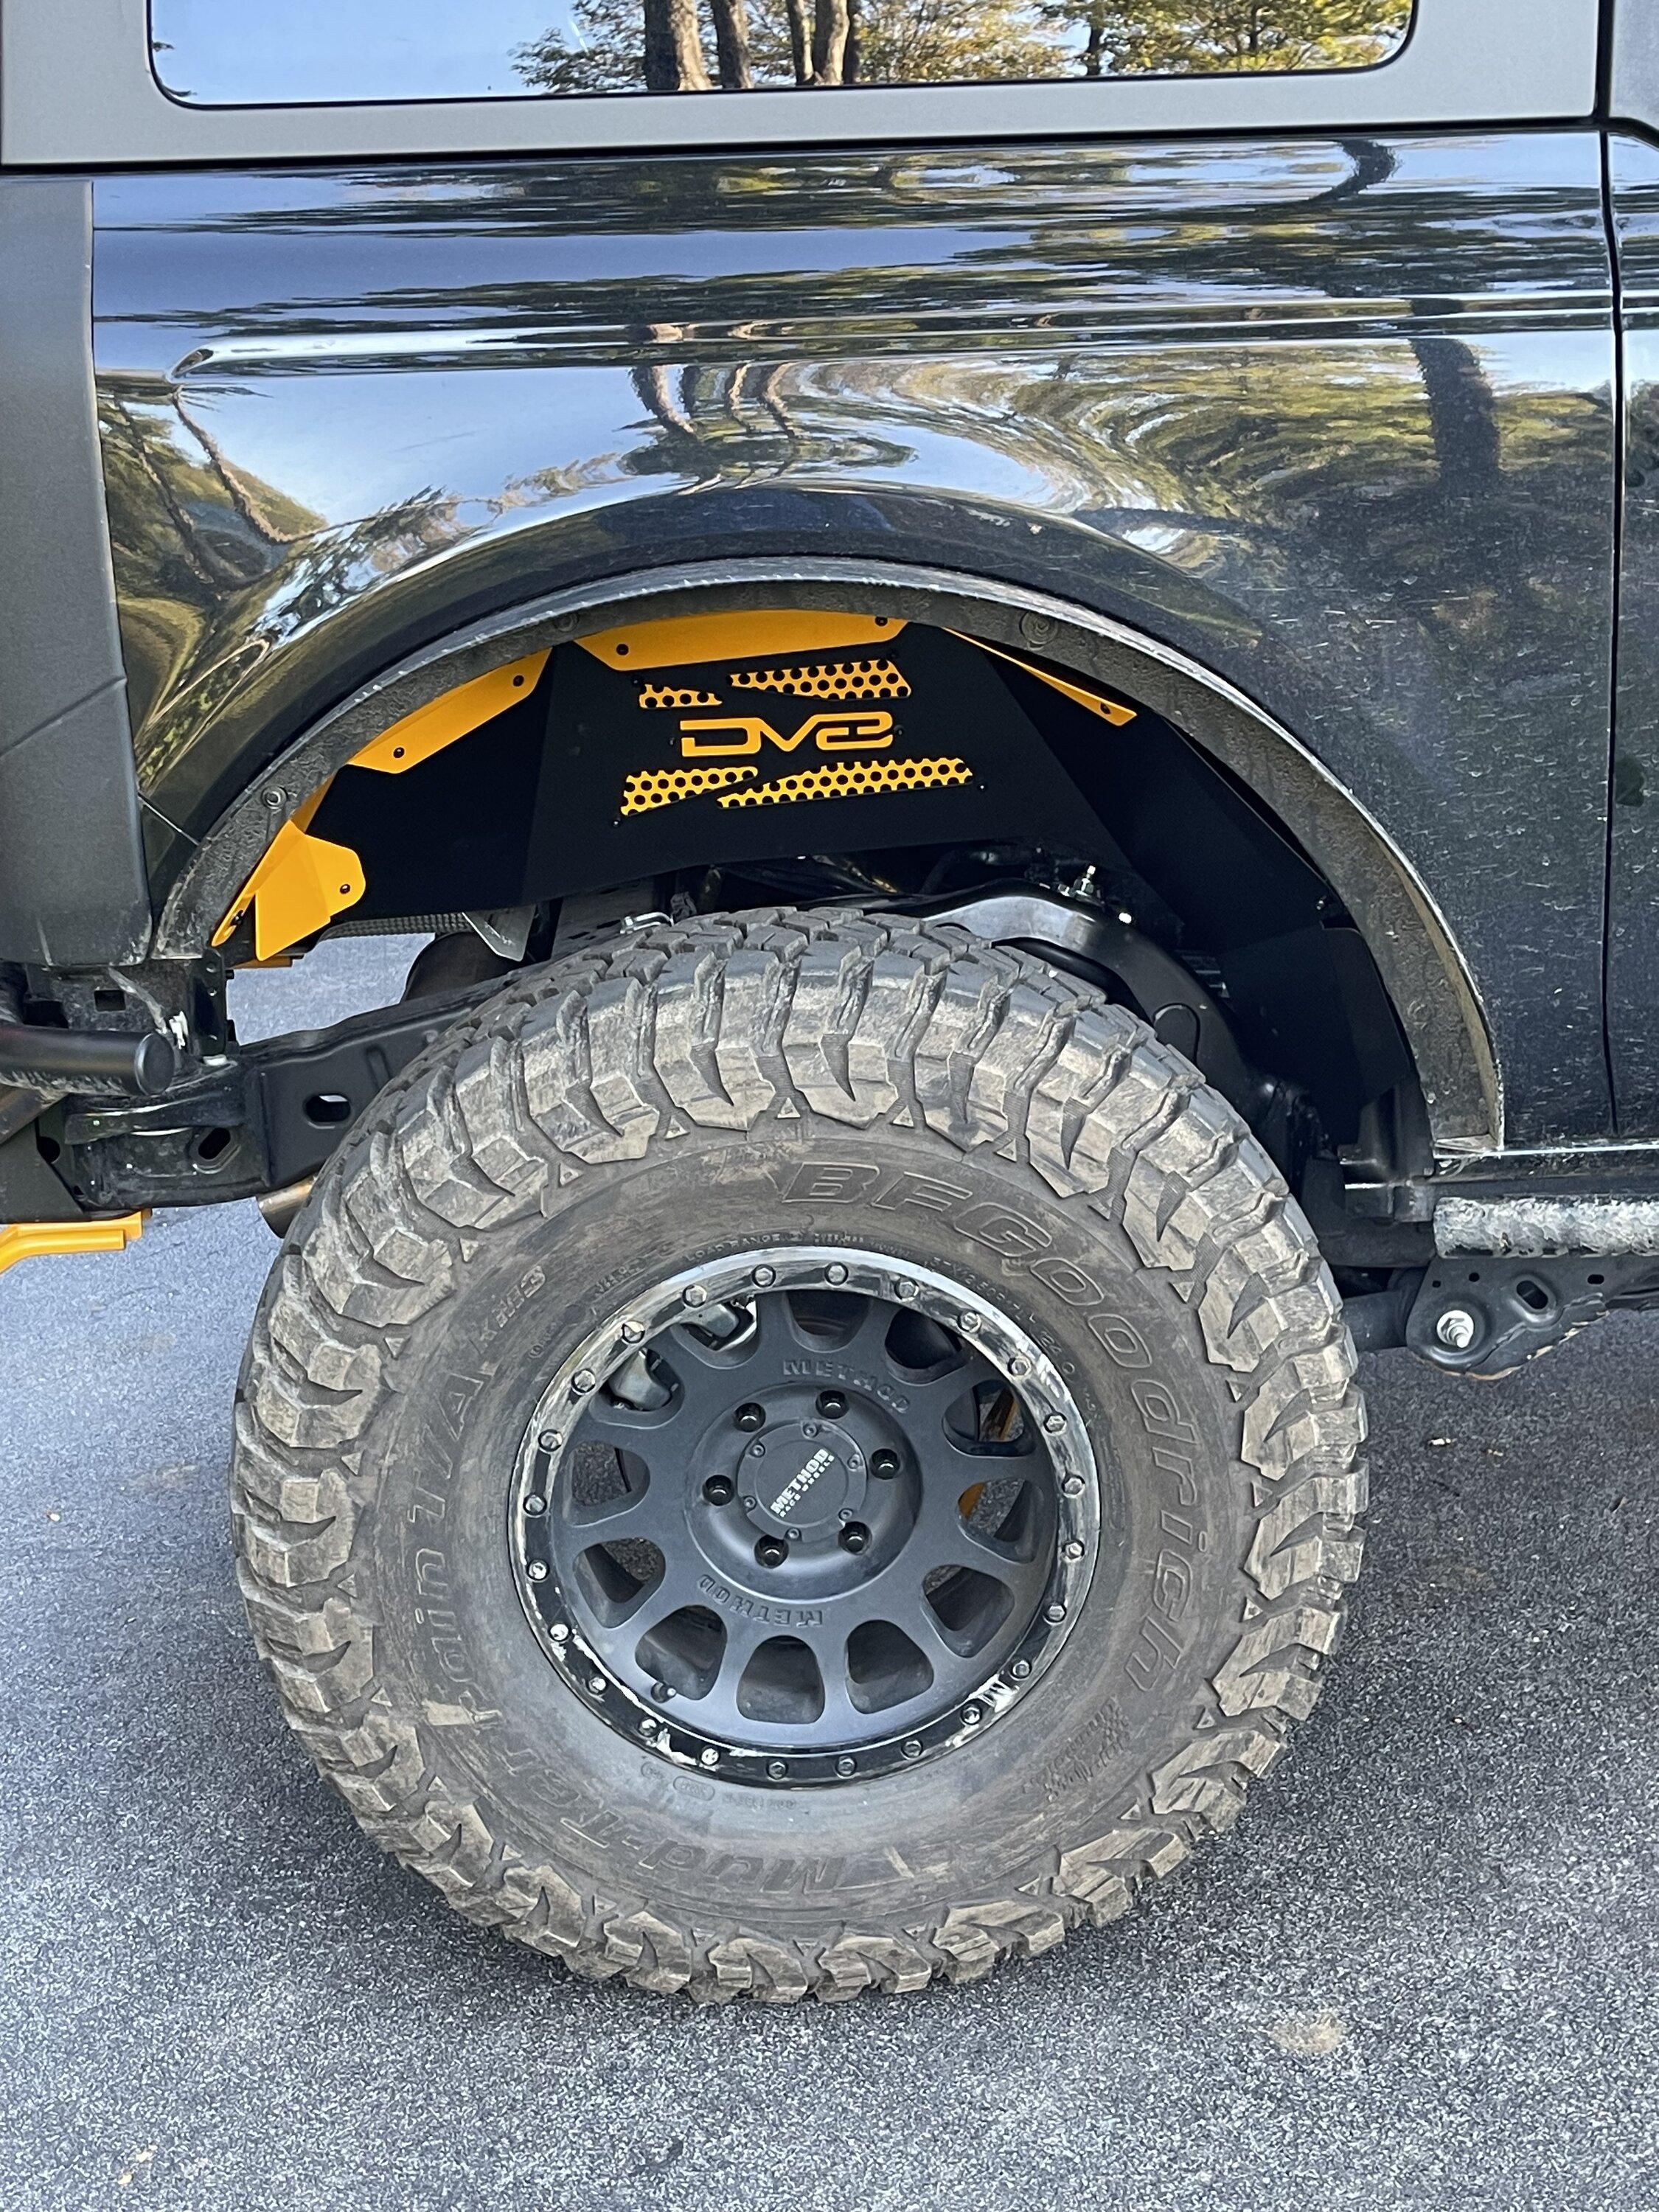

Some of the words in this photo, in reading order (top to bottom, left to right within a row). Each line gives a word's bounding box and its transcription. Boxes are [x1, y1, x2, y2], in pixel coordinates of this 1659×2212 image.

[685, 1242, 725, 1262] LOAD
[728, 1233, 781, 1250] RANGE
[783, 1360, 911, 1414] METHOD
[780, 1161, 1208, 1691] BFGoodrich
[770, 1448, 829, 1514] METHOD
[779, 1493, 801, 1518] RACE
[801, 1455, 835, 1492] WHEELS
[698, 1573, 824, 1628] METHOD
